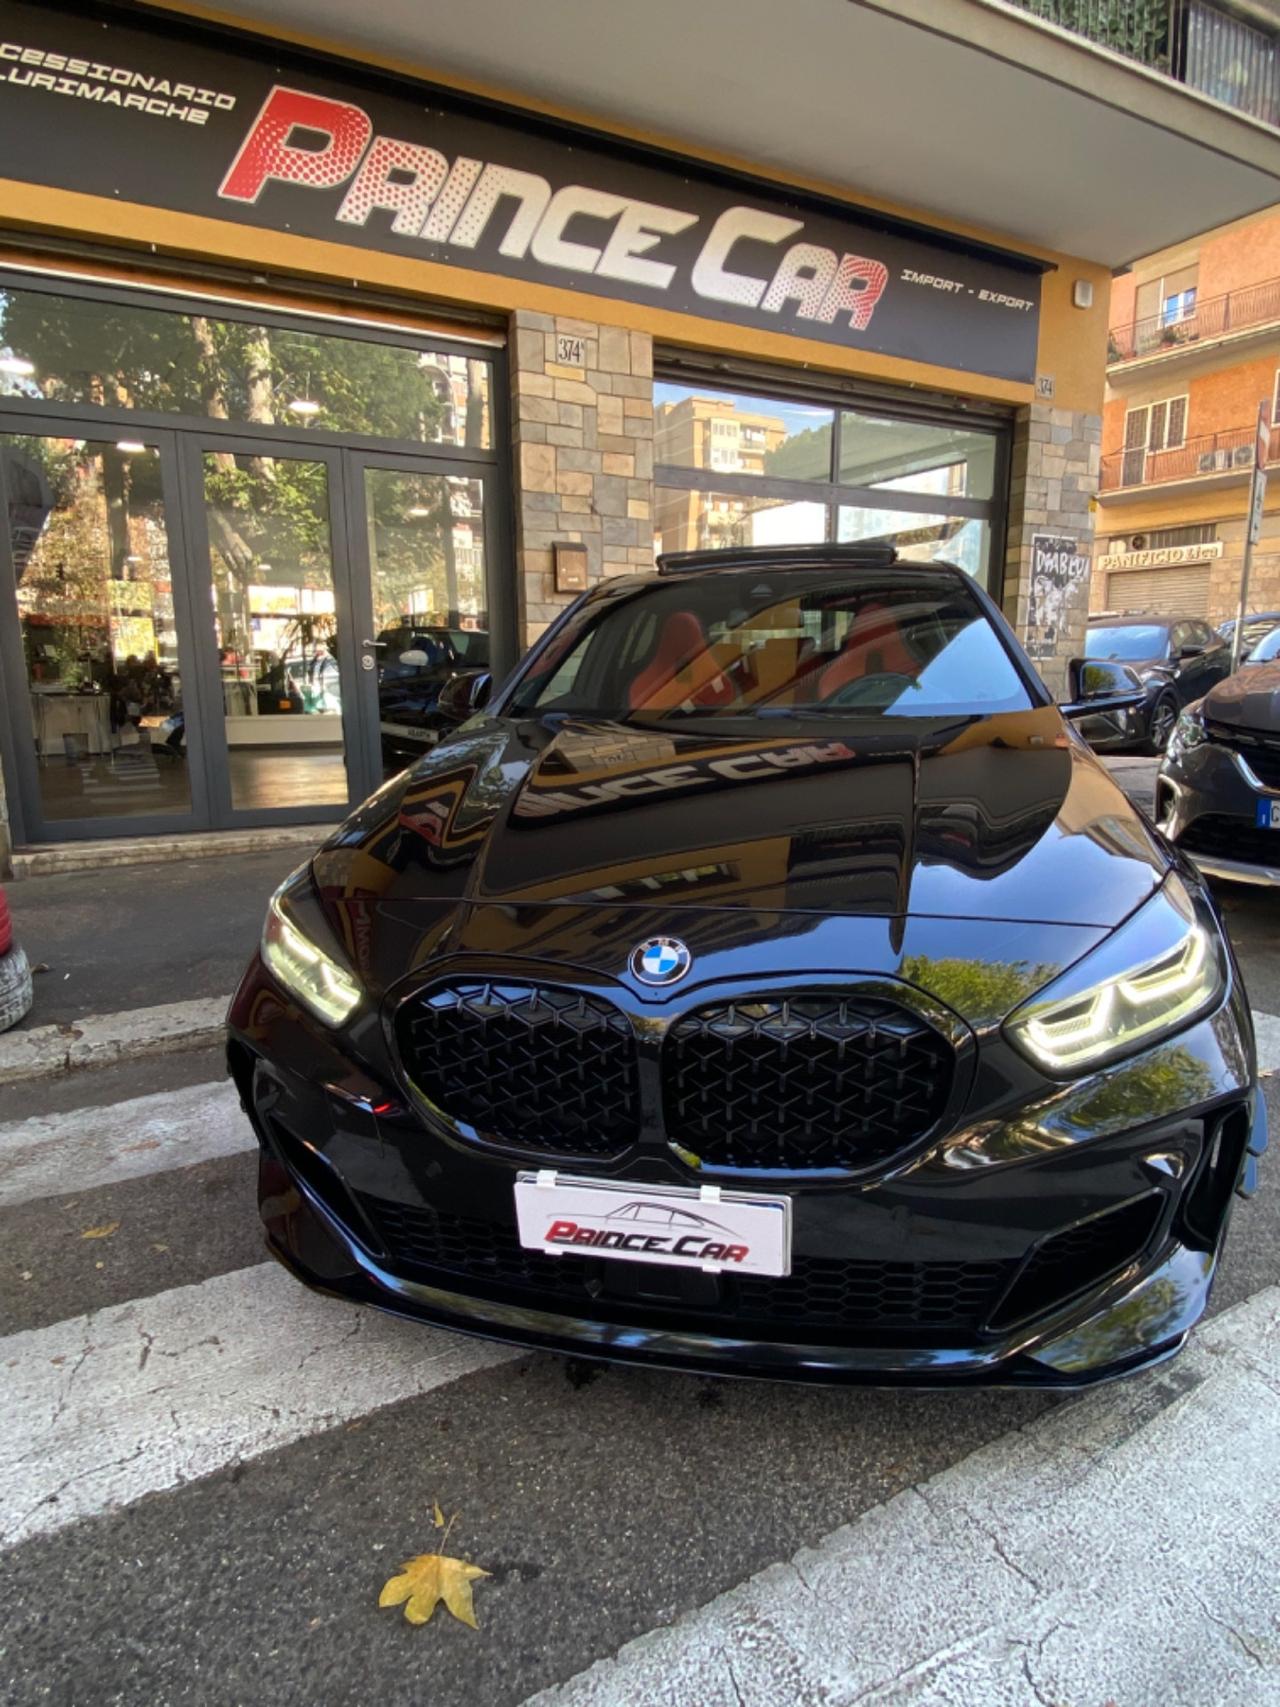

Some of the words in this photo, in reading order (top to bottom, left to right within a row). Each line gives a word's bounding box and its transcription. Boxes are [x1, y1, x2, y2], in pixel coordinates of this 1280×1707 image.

[0, 67, 210, 125] URIMARCHE
[217, 84, 700, 290] PRINCE
[691, 205, 889, 332] CAR
[900, 268, 964, 294] IMPORT
[977, 289, 1035, 312] EXPORT
[1102, 549, 1185, 570] PANIFICIO
[544, 1220, 673, 1251] PRINCE
[667, 1235, 750, 1263] CAR
